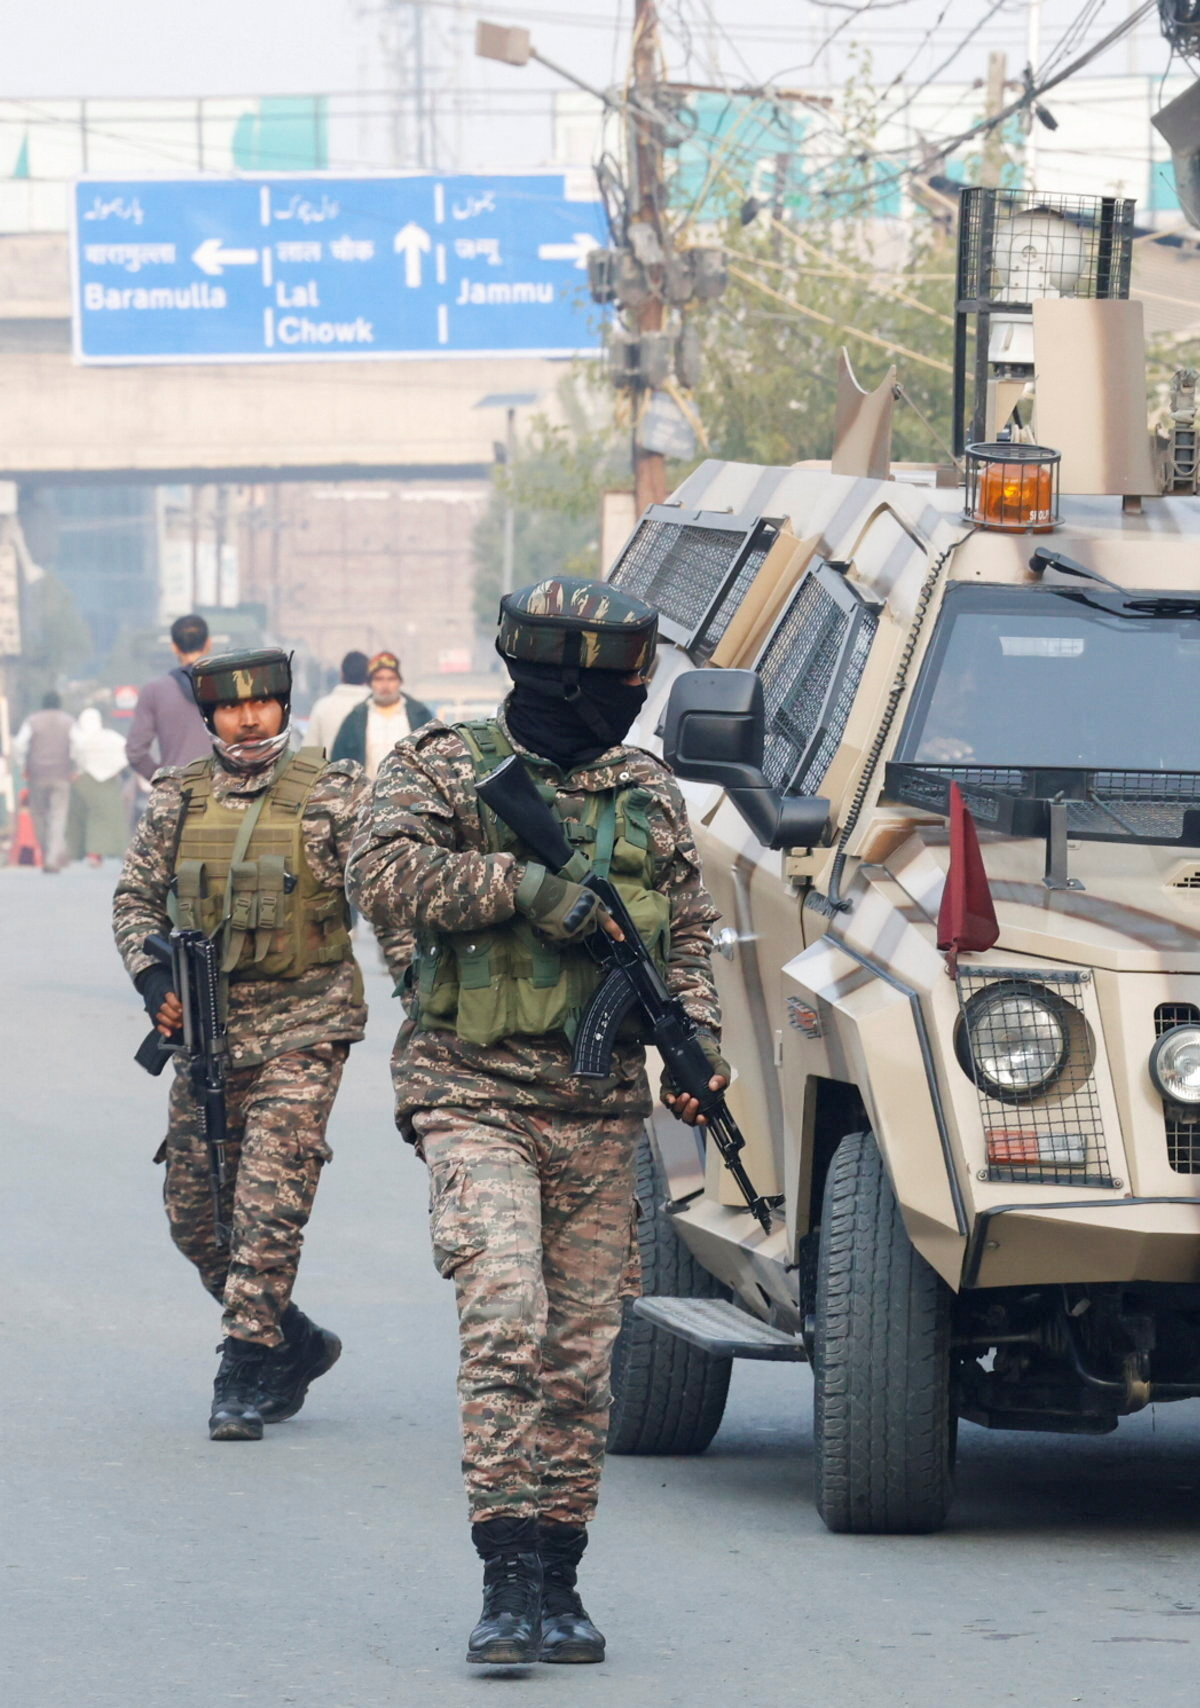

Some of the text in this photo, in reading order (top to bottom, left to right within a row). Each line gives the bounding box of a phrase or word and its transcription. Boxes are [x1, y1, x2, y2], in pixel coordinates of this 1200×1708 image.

[84, 282, 228, 311] Baramulla
[276, 280, 320, 308] Lal
[456, 278, 555, 305] Jammu
[277, 316, 375, 345] Chowk
